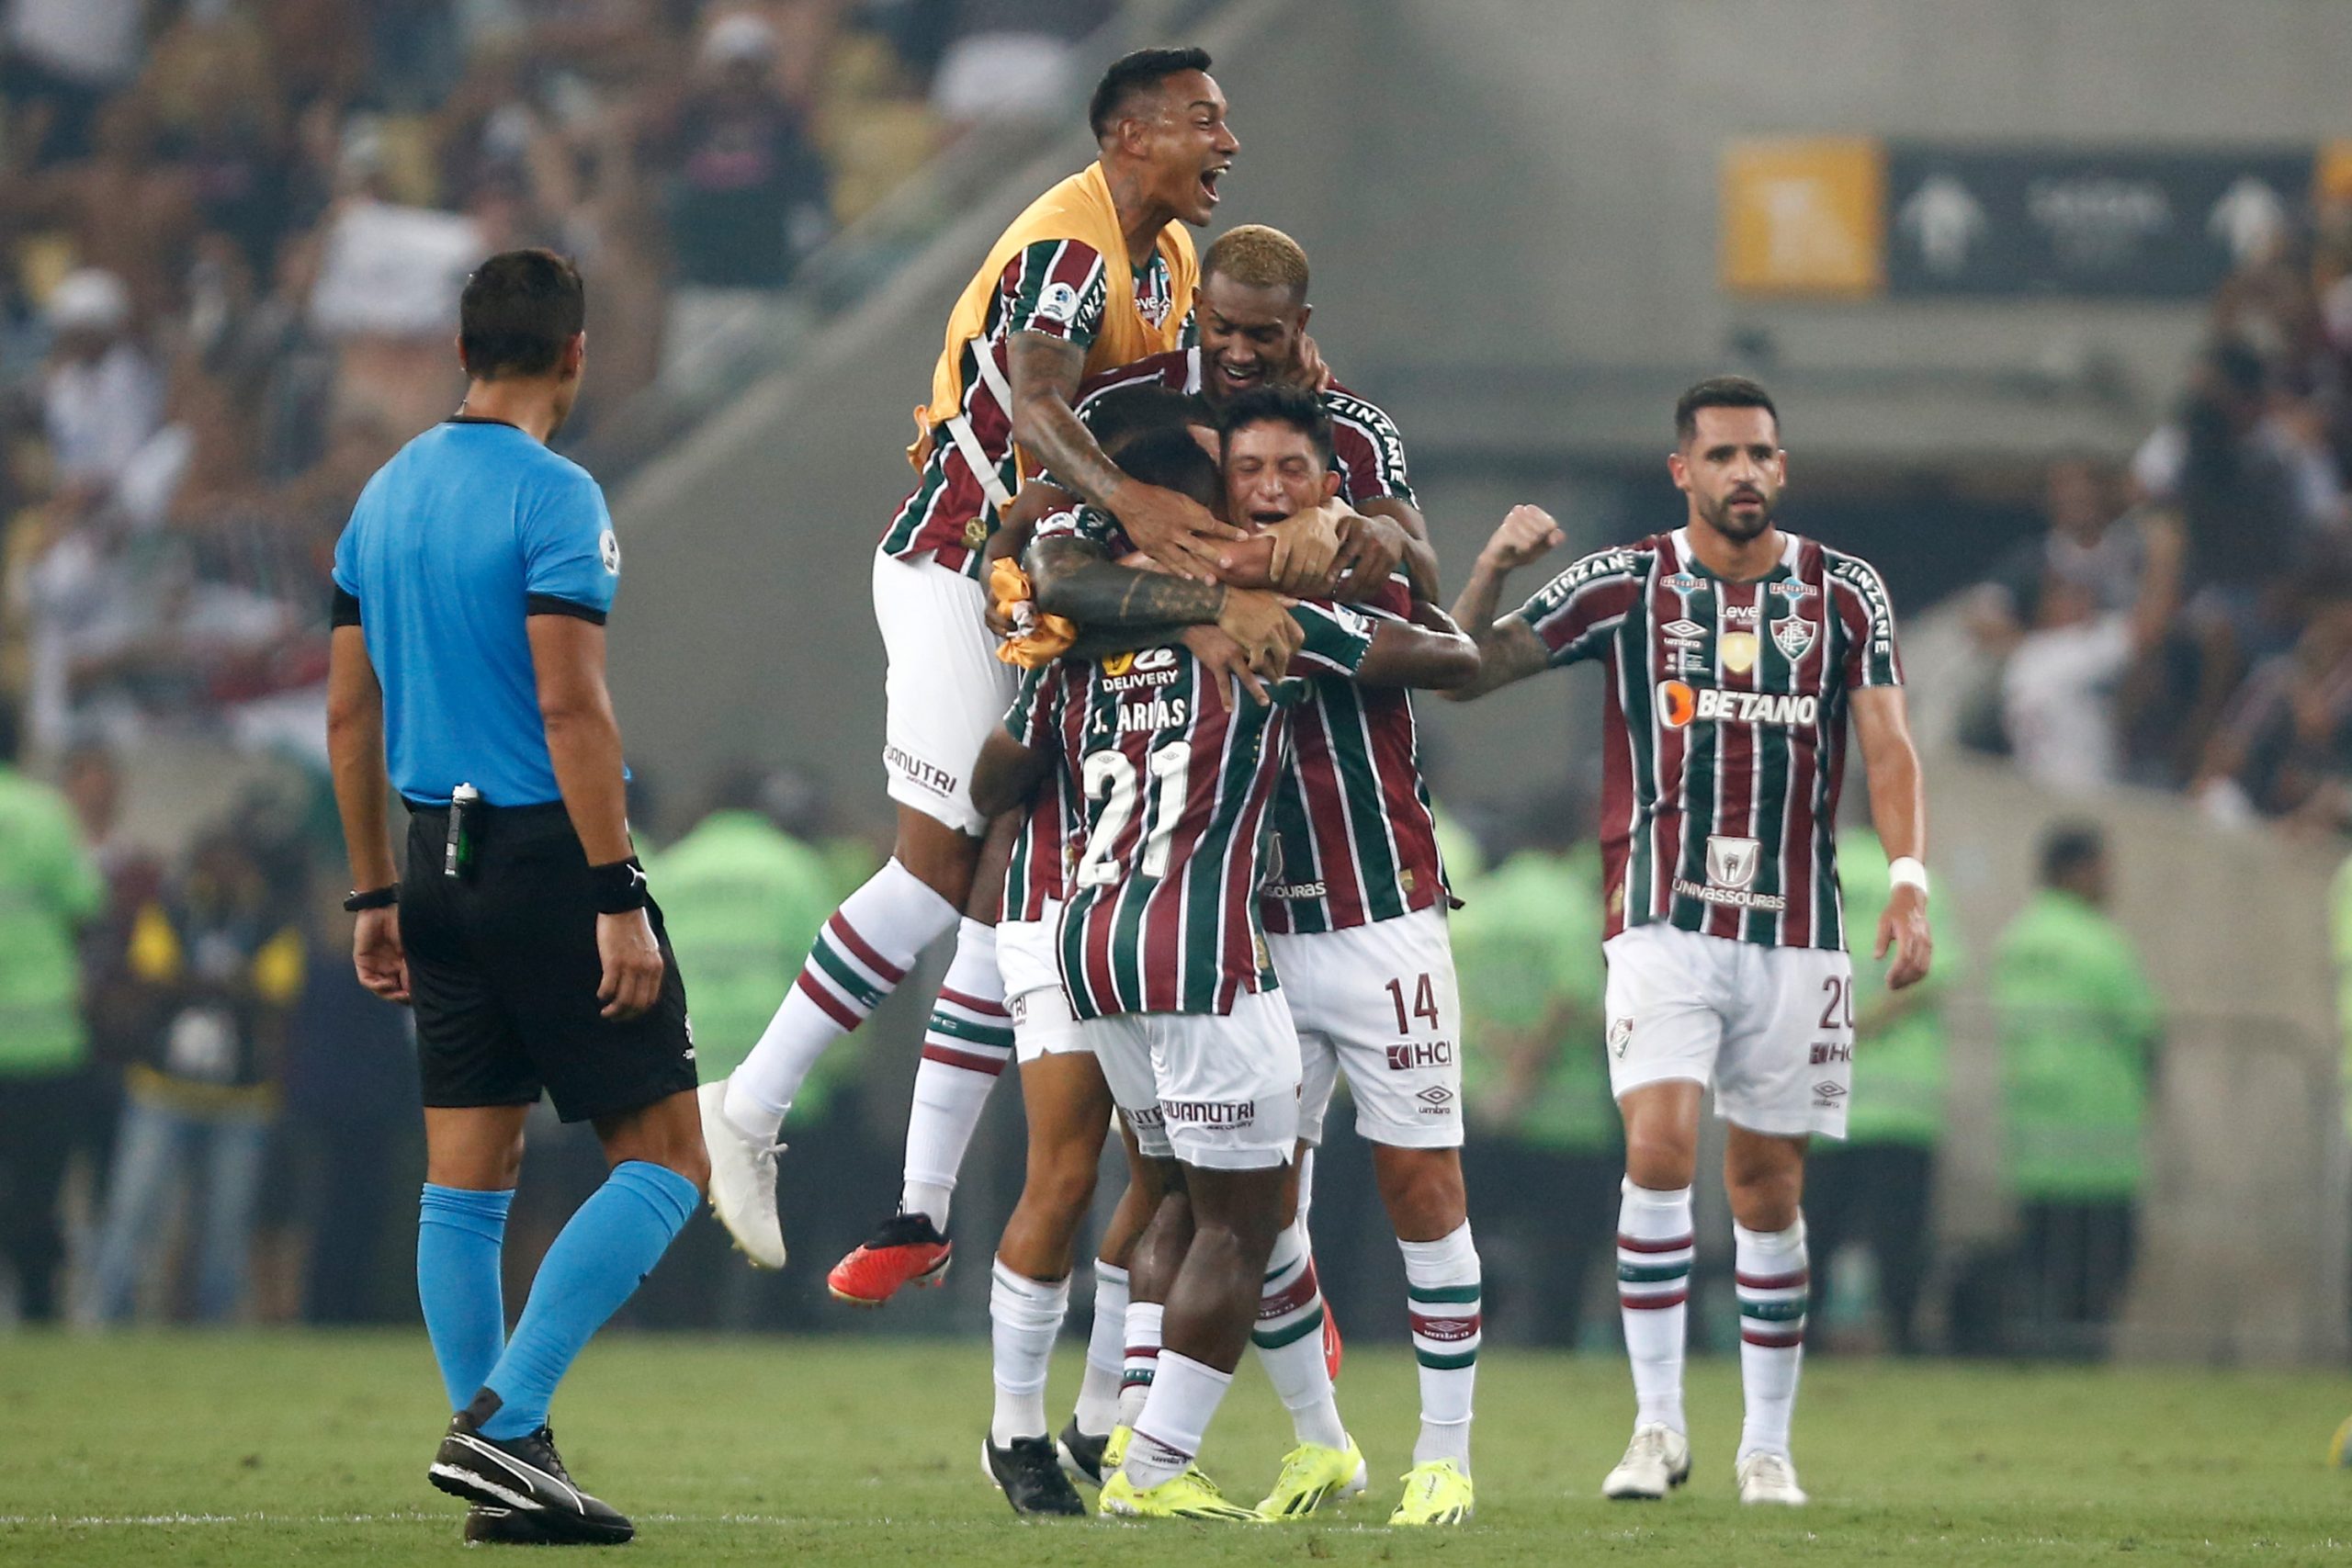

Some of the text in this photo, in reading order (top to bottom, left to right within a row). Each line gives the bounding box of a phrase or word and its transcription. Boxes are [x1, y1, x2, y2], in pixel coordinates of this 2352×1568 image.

[1134, 296, 1159, 311] eve
[1327, 397, 1404, 483] ZINZANE
[1540, 551, 1636, 607] ZINZANE
[1833, 561, 1890, 653] ZINZANE
[1102, 669, 1178, 693] DELIVERY
[1092, 698, 1185, 734] J. ARIAS
[1696, 688, 1817, 724] BETANO
[1077, 740, 1192, 889] 21
[1385, 972, 1439, 1034] 14
[1415, 1040, 1452, 1065] HCI
[1419, 1105, 1451, 1114] umbro
